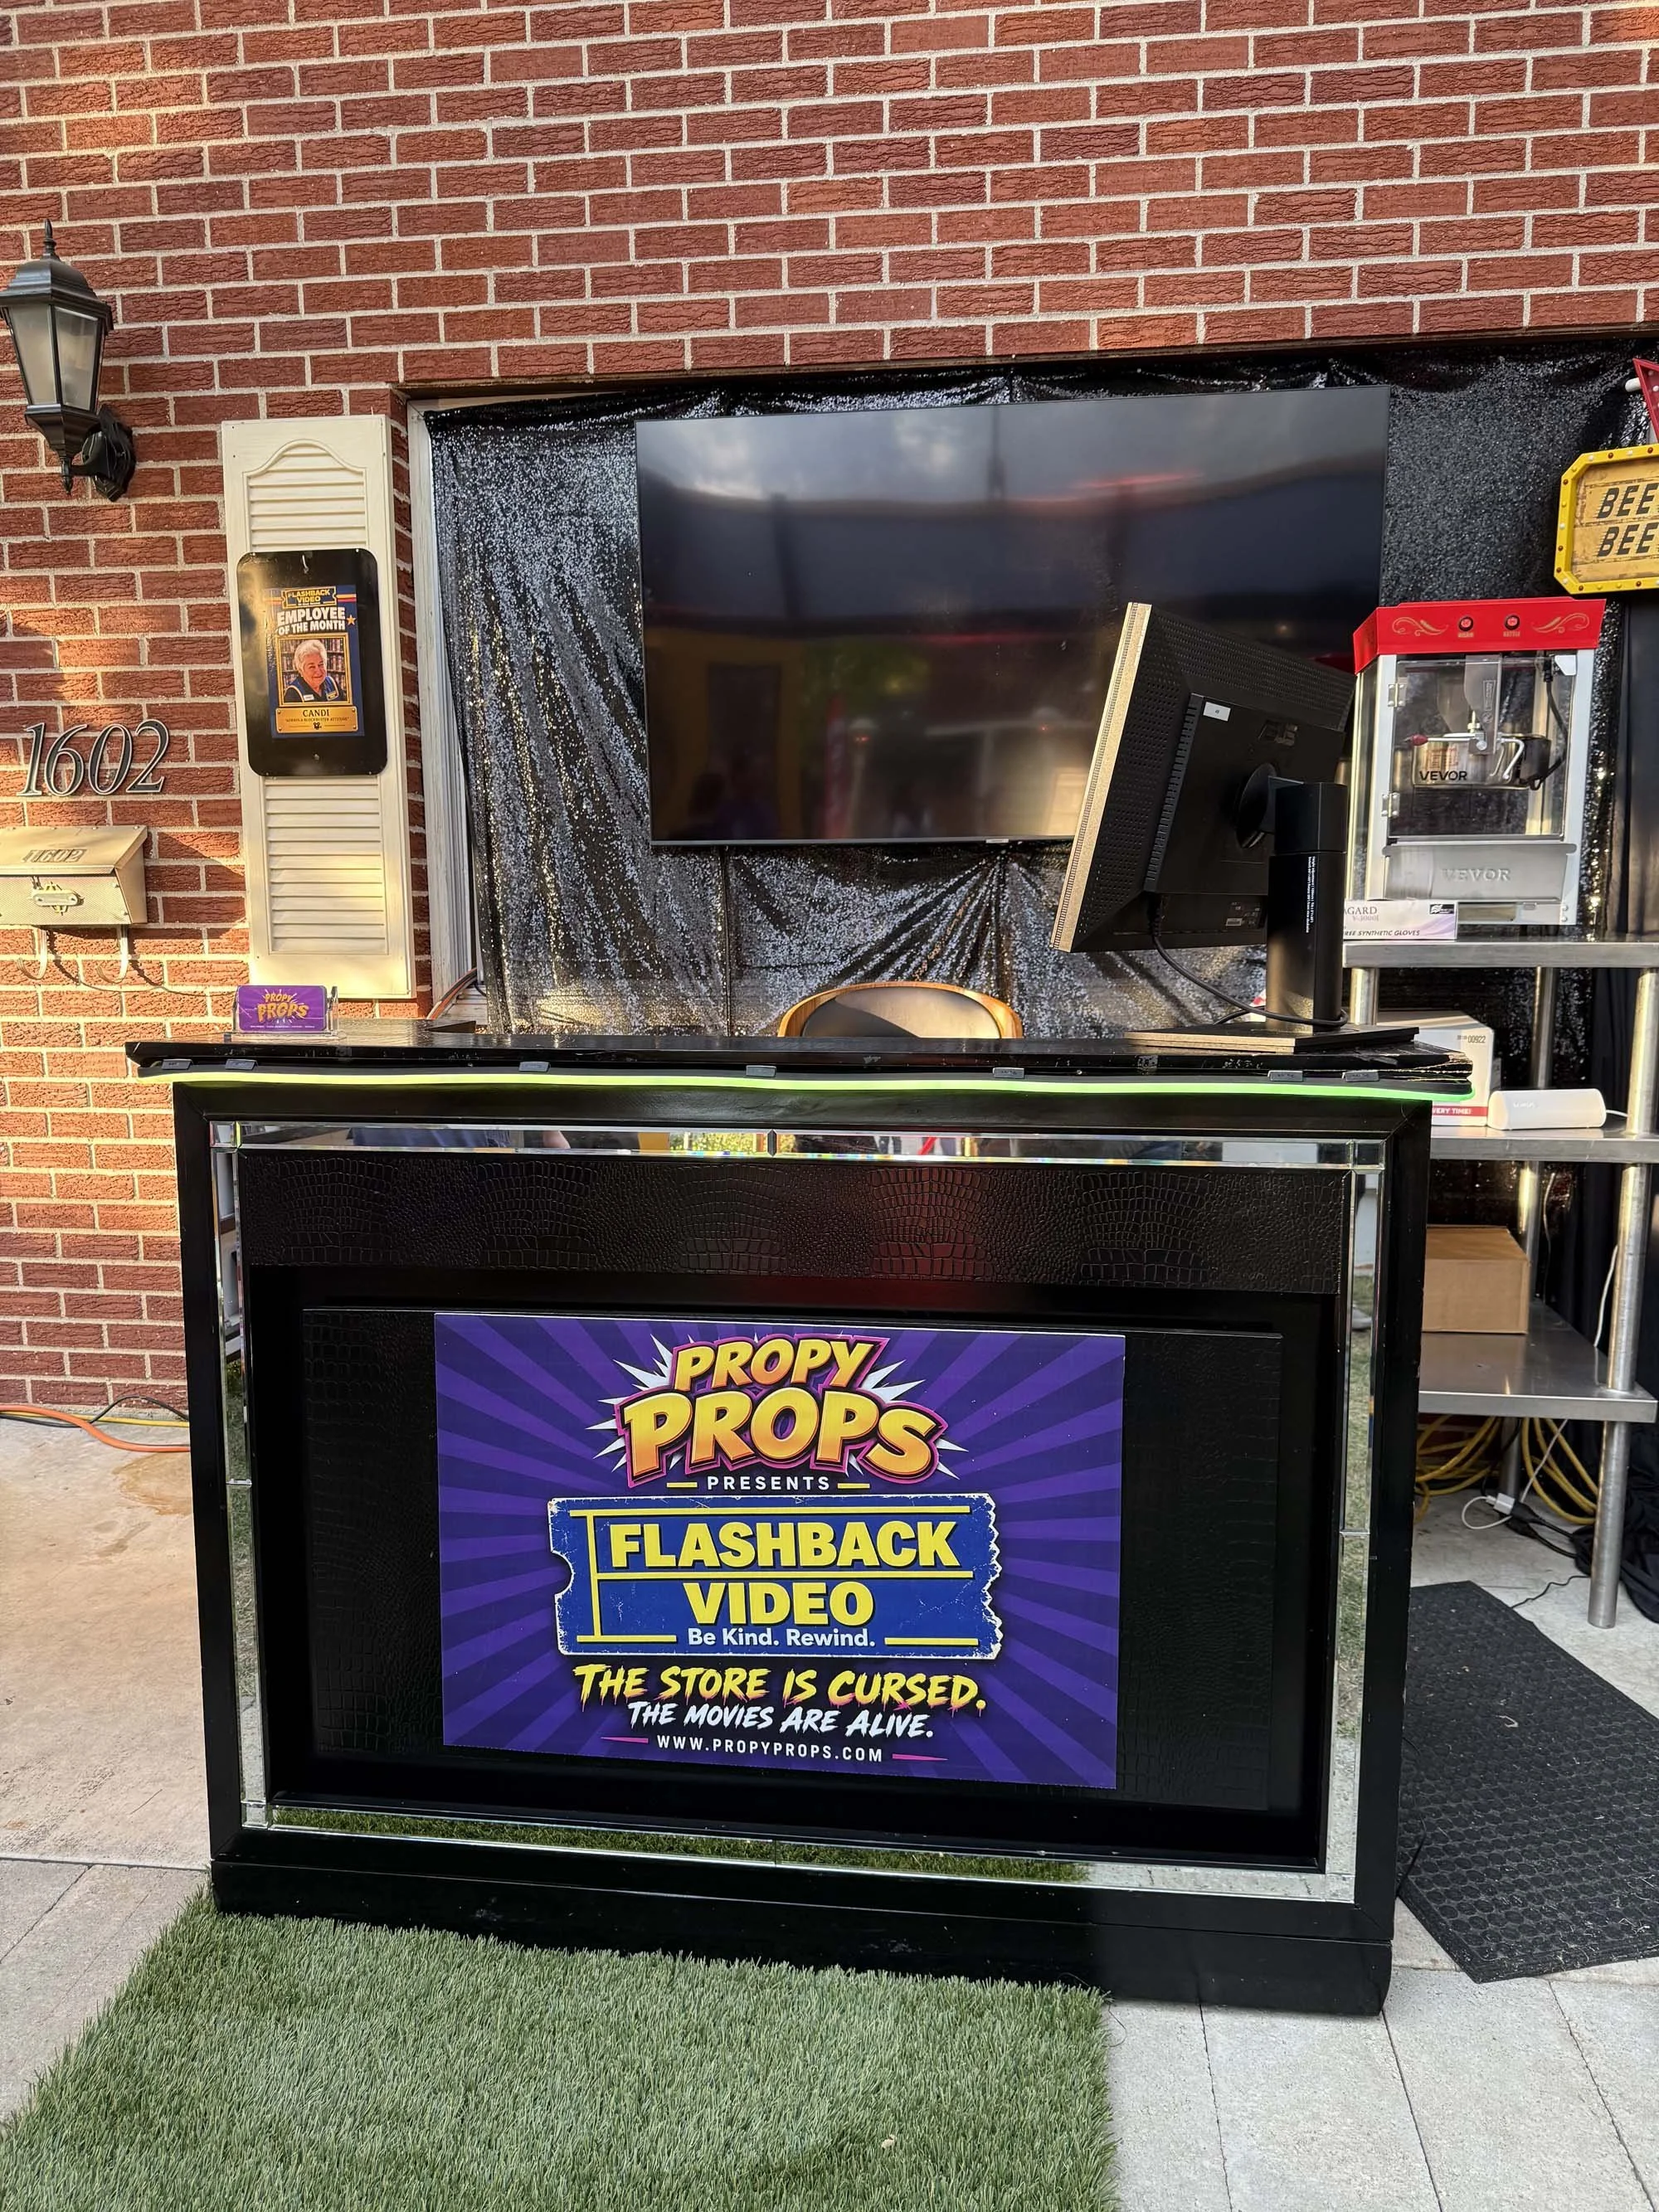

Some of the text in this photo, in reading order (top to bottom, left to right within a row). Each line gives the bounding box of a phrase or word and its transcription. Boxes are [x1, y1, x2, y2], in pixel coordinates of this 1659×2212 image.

[288, 589, 331, 598] FLASHBACK
[276, 607, 346, 626] EMPLOYEE
[278, 620, 346, 636] OF THE MONTH
[17, 719, 169, 797] 1602
[1419, 771, 1467, 781] VEVOR
[1443, 868, 1511, 882] VEVOR
[265, 994, 292, 1003] PROPY
[257, 1003, 309, 1023] PROPS
[1467, 1034, 1486, 1043] 00922
[673, 1338, 873, 1392] PROPY
[624, 1388, 938, 1478] PROPS
[708, 1475, 830, 1490] PRESENTS
[611, 1521, 961, 1568] FLASHBACK
[684, 1581, 874, 1625] VIDEO
[688, 1628, 876, 1647] Be Kind. Rewind.
[574, 1663, 987, 1711] THE STORE IS CURSED.
[628, 1700, 934, 1738] THE MOVIES ARE ALIVE.
[656, 1735, 883, 1763] WWW.PROPYPROPS.COM
